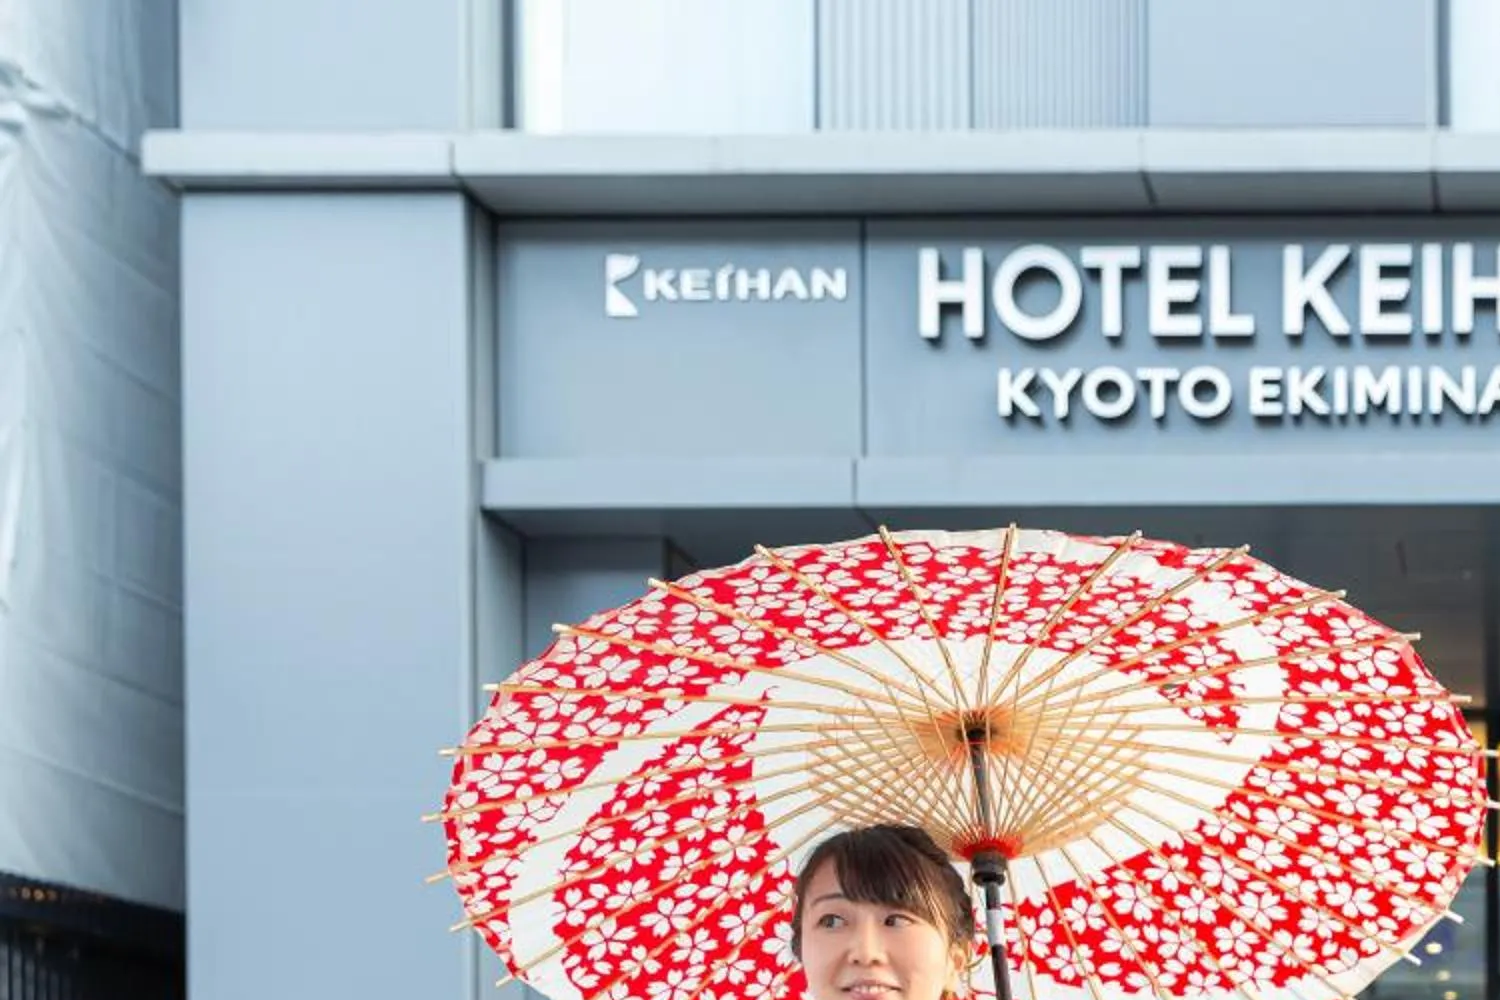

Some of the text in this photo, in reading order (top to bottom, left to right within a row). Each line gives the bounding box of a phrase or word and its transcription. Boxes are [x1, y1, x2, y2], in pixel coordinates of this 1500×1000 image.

[642, 263, 848, 302] KEIHAN
[918, 246, 1256, 341] HOTEL
[996, 364, 1234, 419] KYOTO
